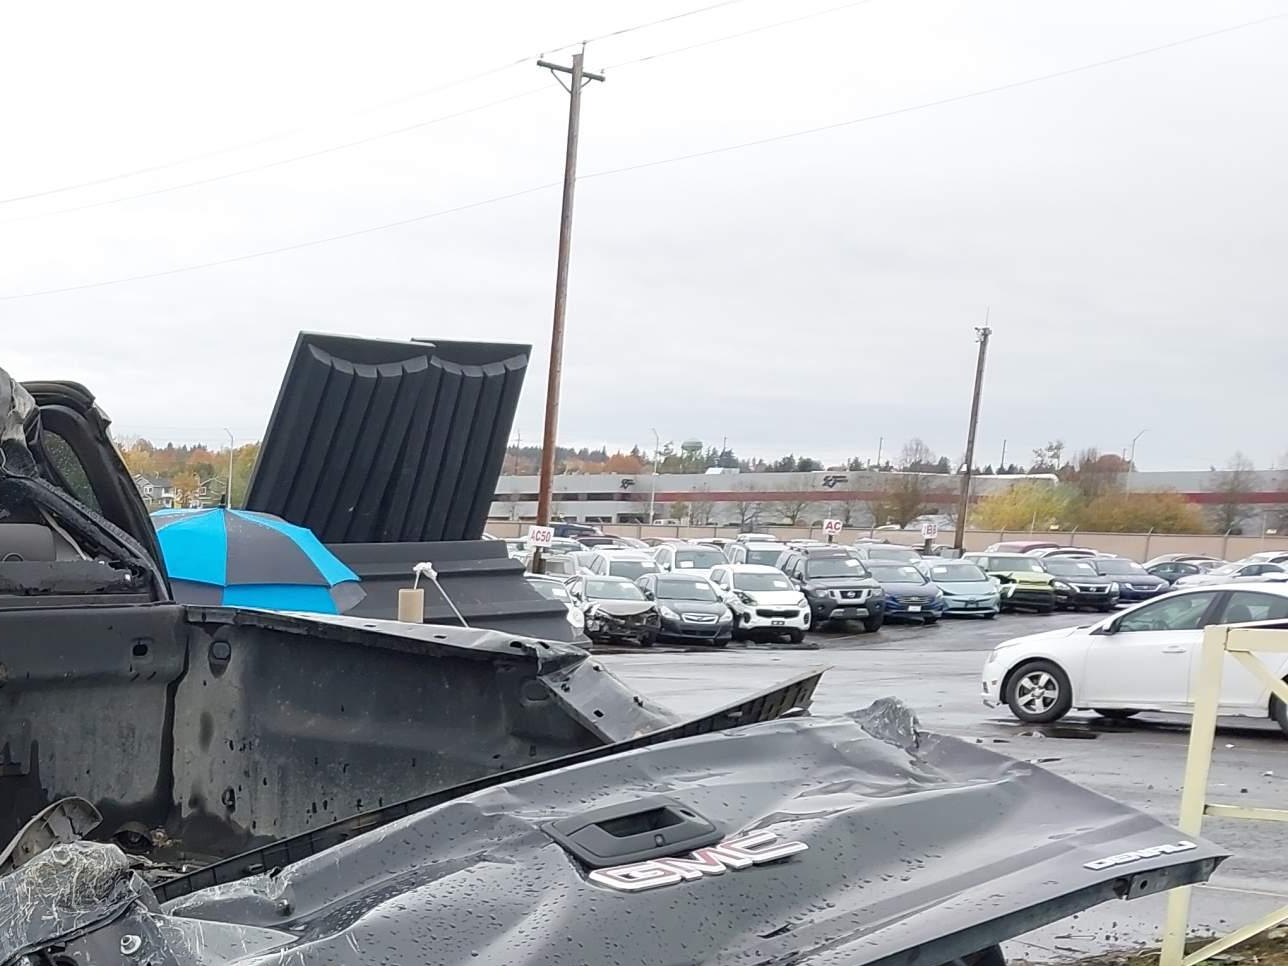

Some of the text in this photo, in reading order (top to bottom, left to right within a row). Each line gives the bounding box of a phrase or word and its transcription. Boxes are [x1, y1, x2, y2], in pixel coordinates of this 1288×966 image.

[531, 530, 552, 543] AC50
[588, 829, 809, 893] GMC
[1083, 840, 1198, 871] DENALI
